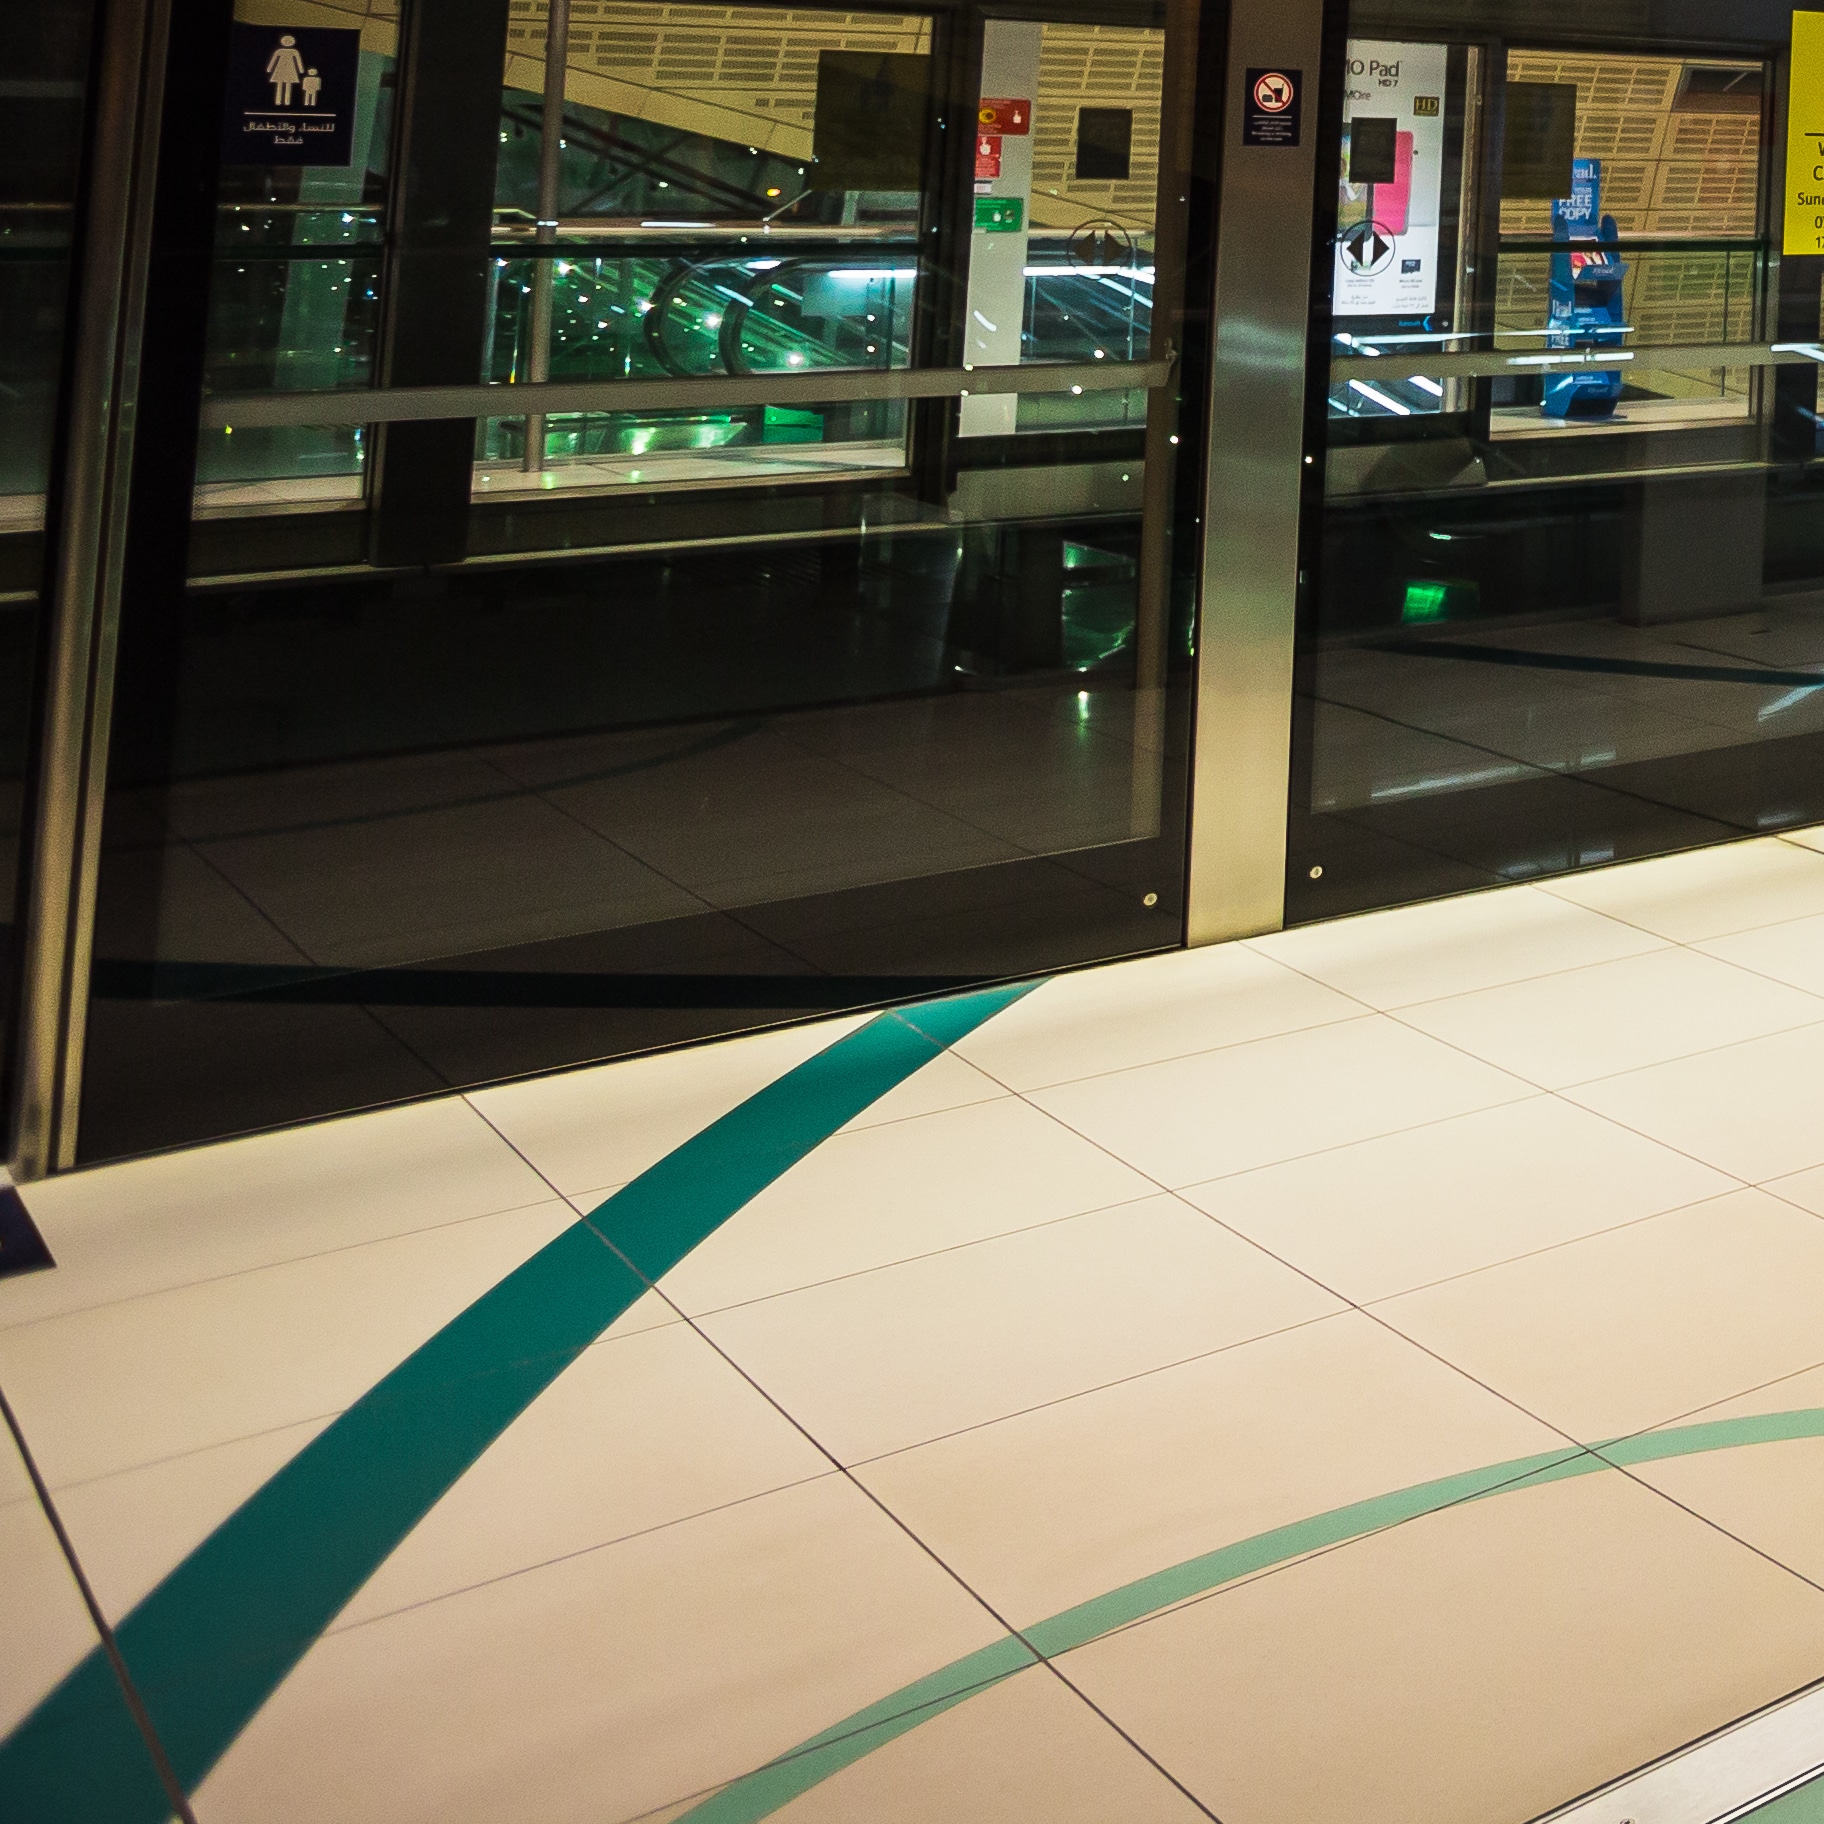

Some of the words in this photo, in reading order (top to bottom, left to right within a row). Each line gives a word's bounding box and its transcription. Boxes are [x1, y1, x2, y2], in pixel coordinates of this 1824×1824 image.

[1369, 60, 1400, 77] Pad
[1415, 98, 1438, 111] HD
[1559, 194, 1592, 207] FREE
[1559, 207, 1592, 220] COPY
